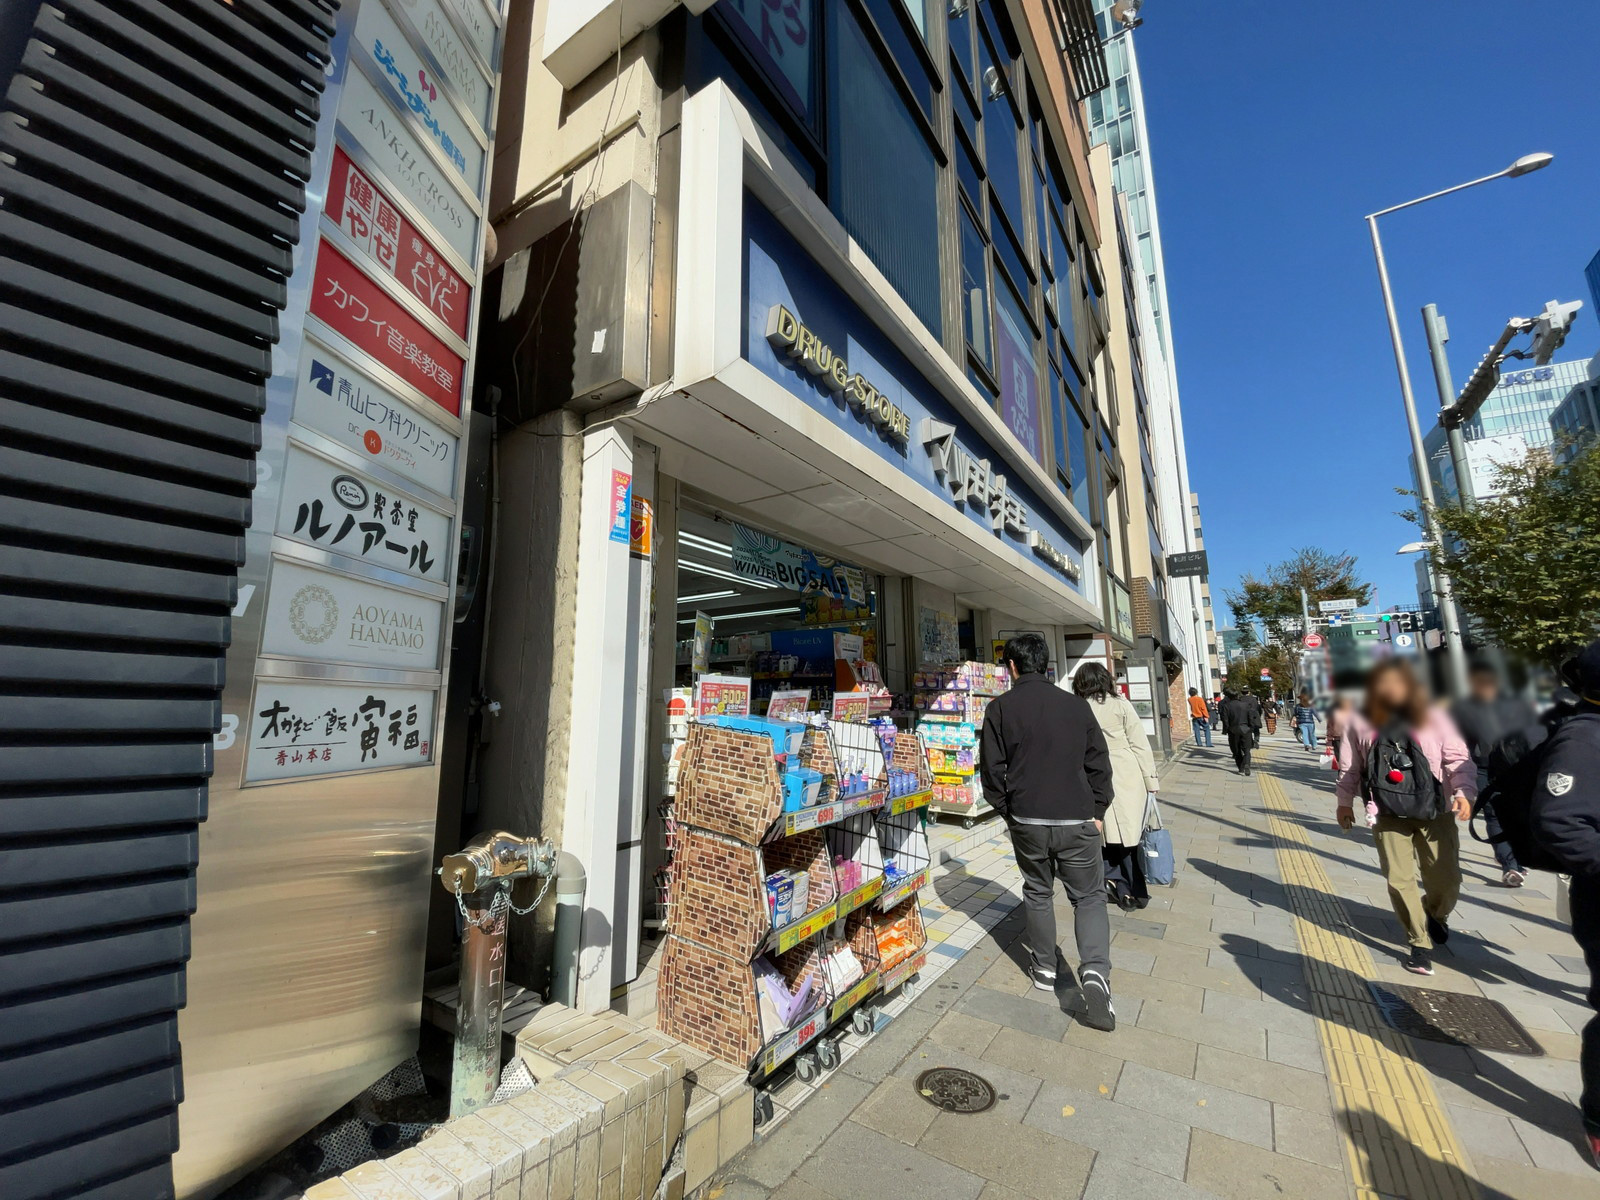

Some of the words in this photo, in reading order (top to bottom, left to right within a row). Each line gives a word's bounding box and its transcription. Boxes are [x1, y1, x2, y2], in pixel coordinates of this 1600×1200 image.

[361, 107, 416, 171] ANKH
[418, 170, 464, 230] CROSS
[349, 171, 400, 241] 健康
[346, 208, 395, 270] やせ
[411, 261, 455, 323] EVE
[324, 277, 454, 393] カワイ音楽教室
[766, 303, 849, 391] DRUG
[845, 373, 911, 443] STORE
[338, 376, 449, 461] 青山ヒフ科クリニック
[293, 499, 434, 574] ルノアール
[373, 492, 418, 533] 喫茶室
[734, 559, 778, 581] WINTER
[776, 561, 807, 588] BIG
[809, 569, 849, 595] SALE
[350, 624, 424, 649] HANAMO
[352, 604, 424, 631] AOYAMA
[275, 748, 332, 766] 青山本店
[798, 1019, 816, 1046] 398
